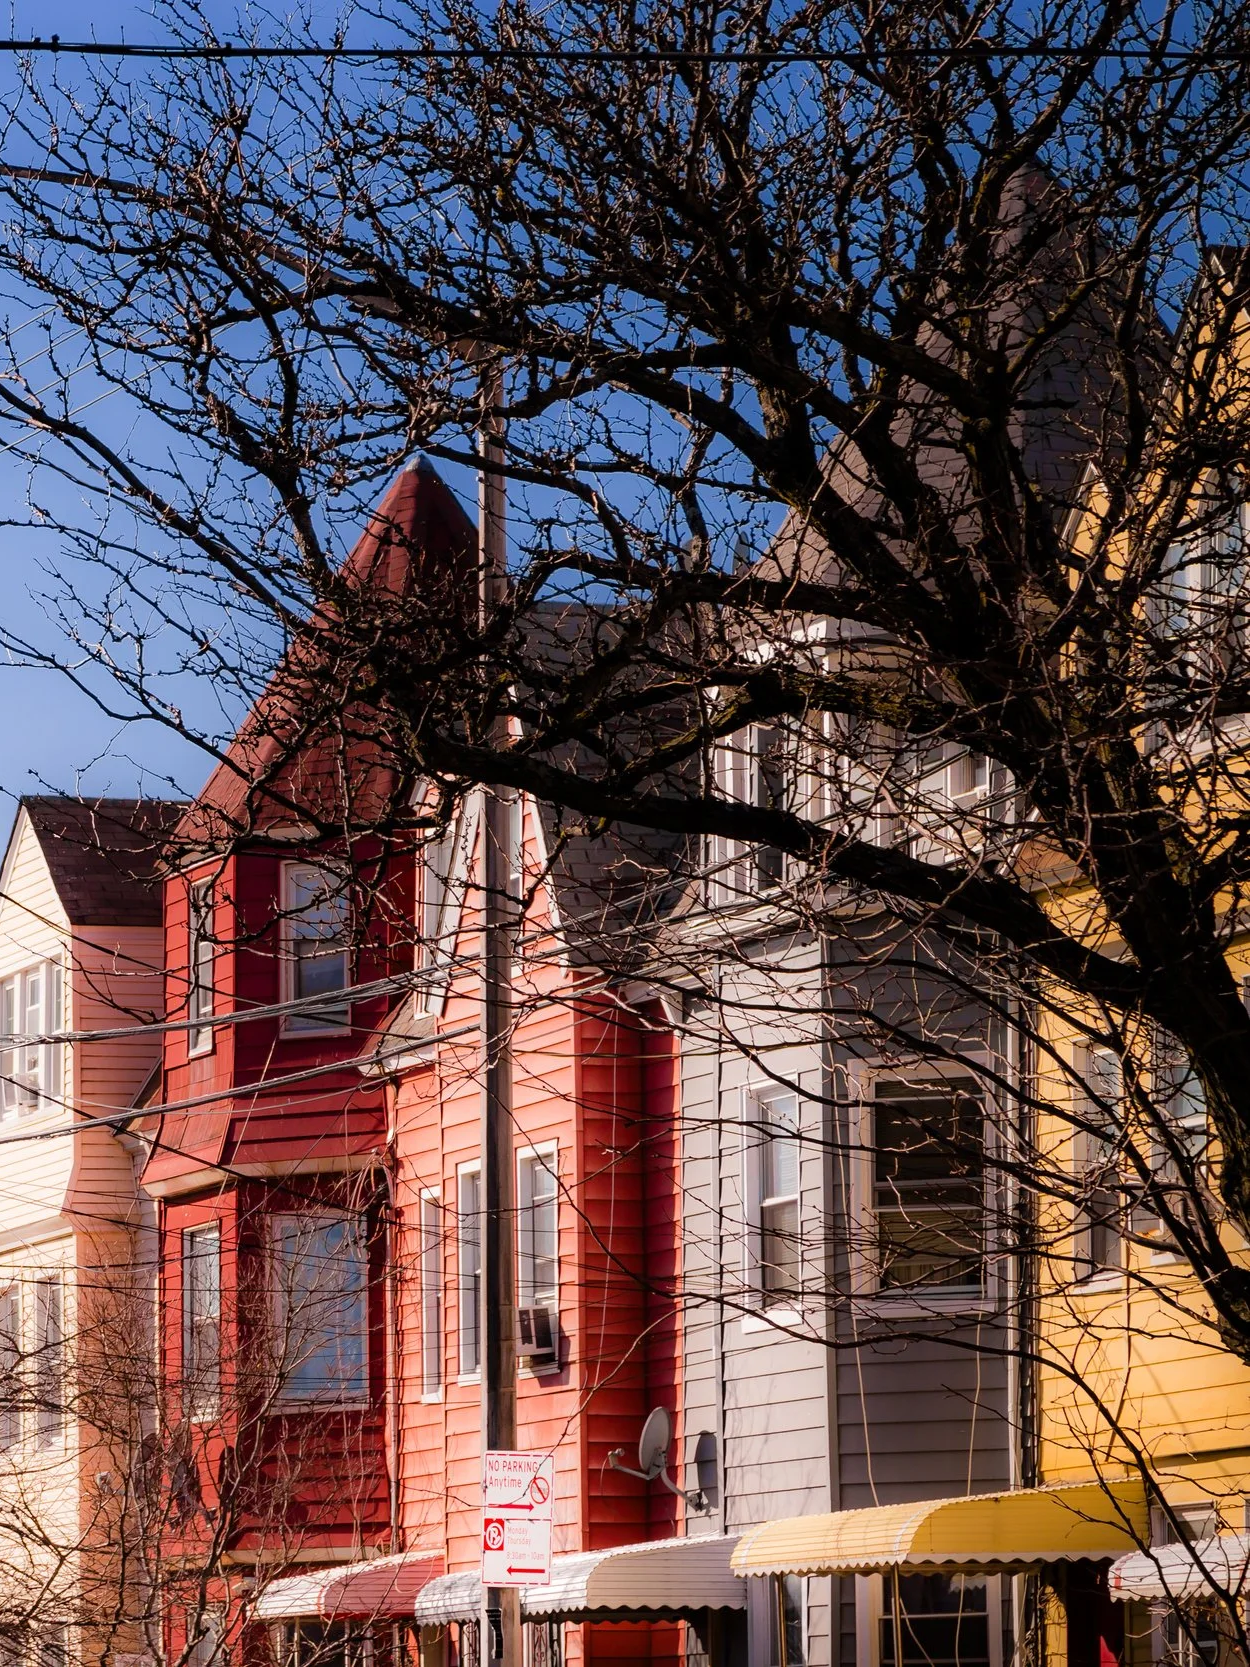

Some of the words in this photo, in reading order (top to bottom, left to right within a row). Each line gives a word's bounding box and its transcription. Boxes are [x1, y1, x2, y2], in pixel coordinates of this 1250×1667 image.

[488, 1460, 500, 1472] NO
[502, 1460, 538, 1473] PARKING
[489, 1475, 522, 1490] Anytime
[507, 1526, 528, 1536] Monday
[507, 1536, 531, 1546] Thursday
